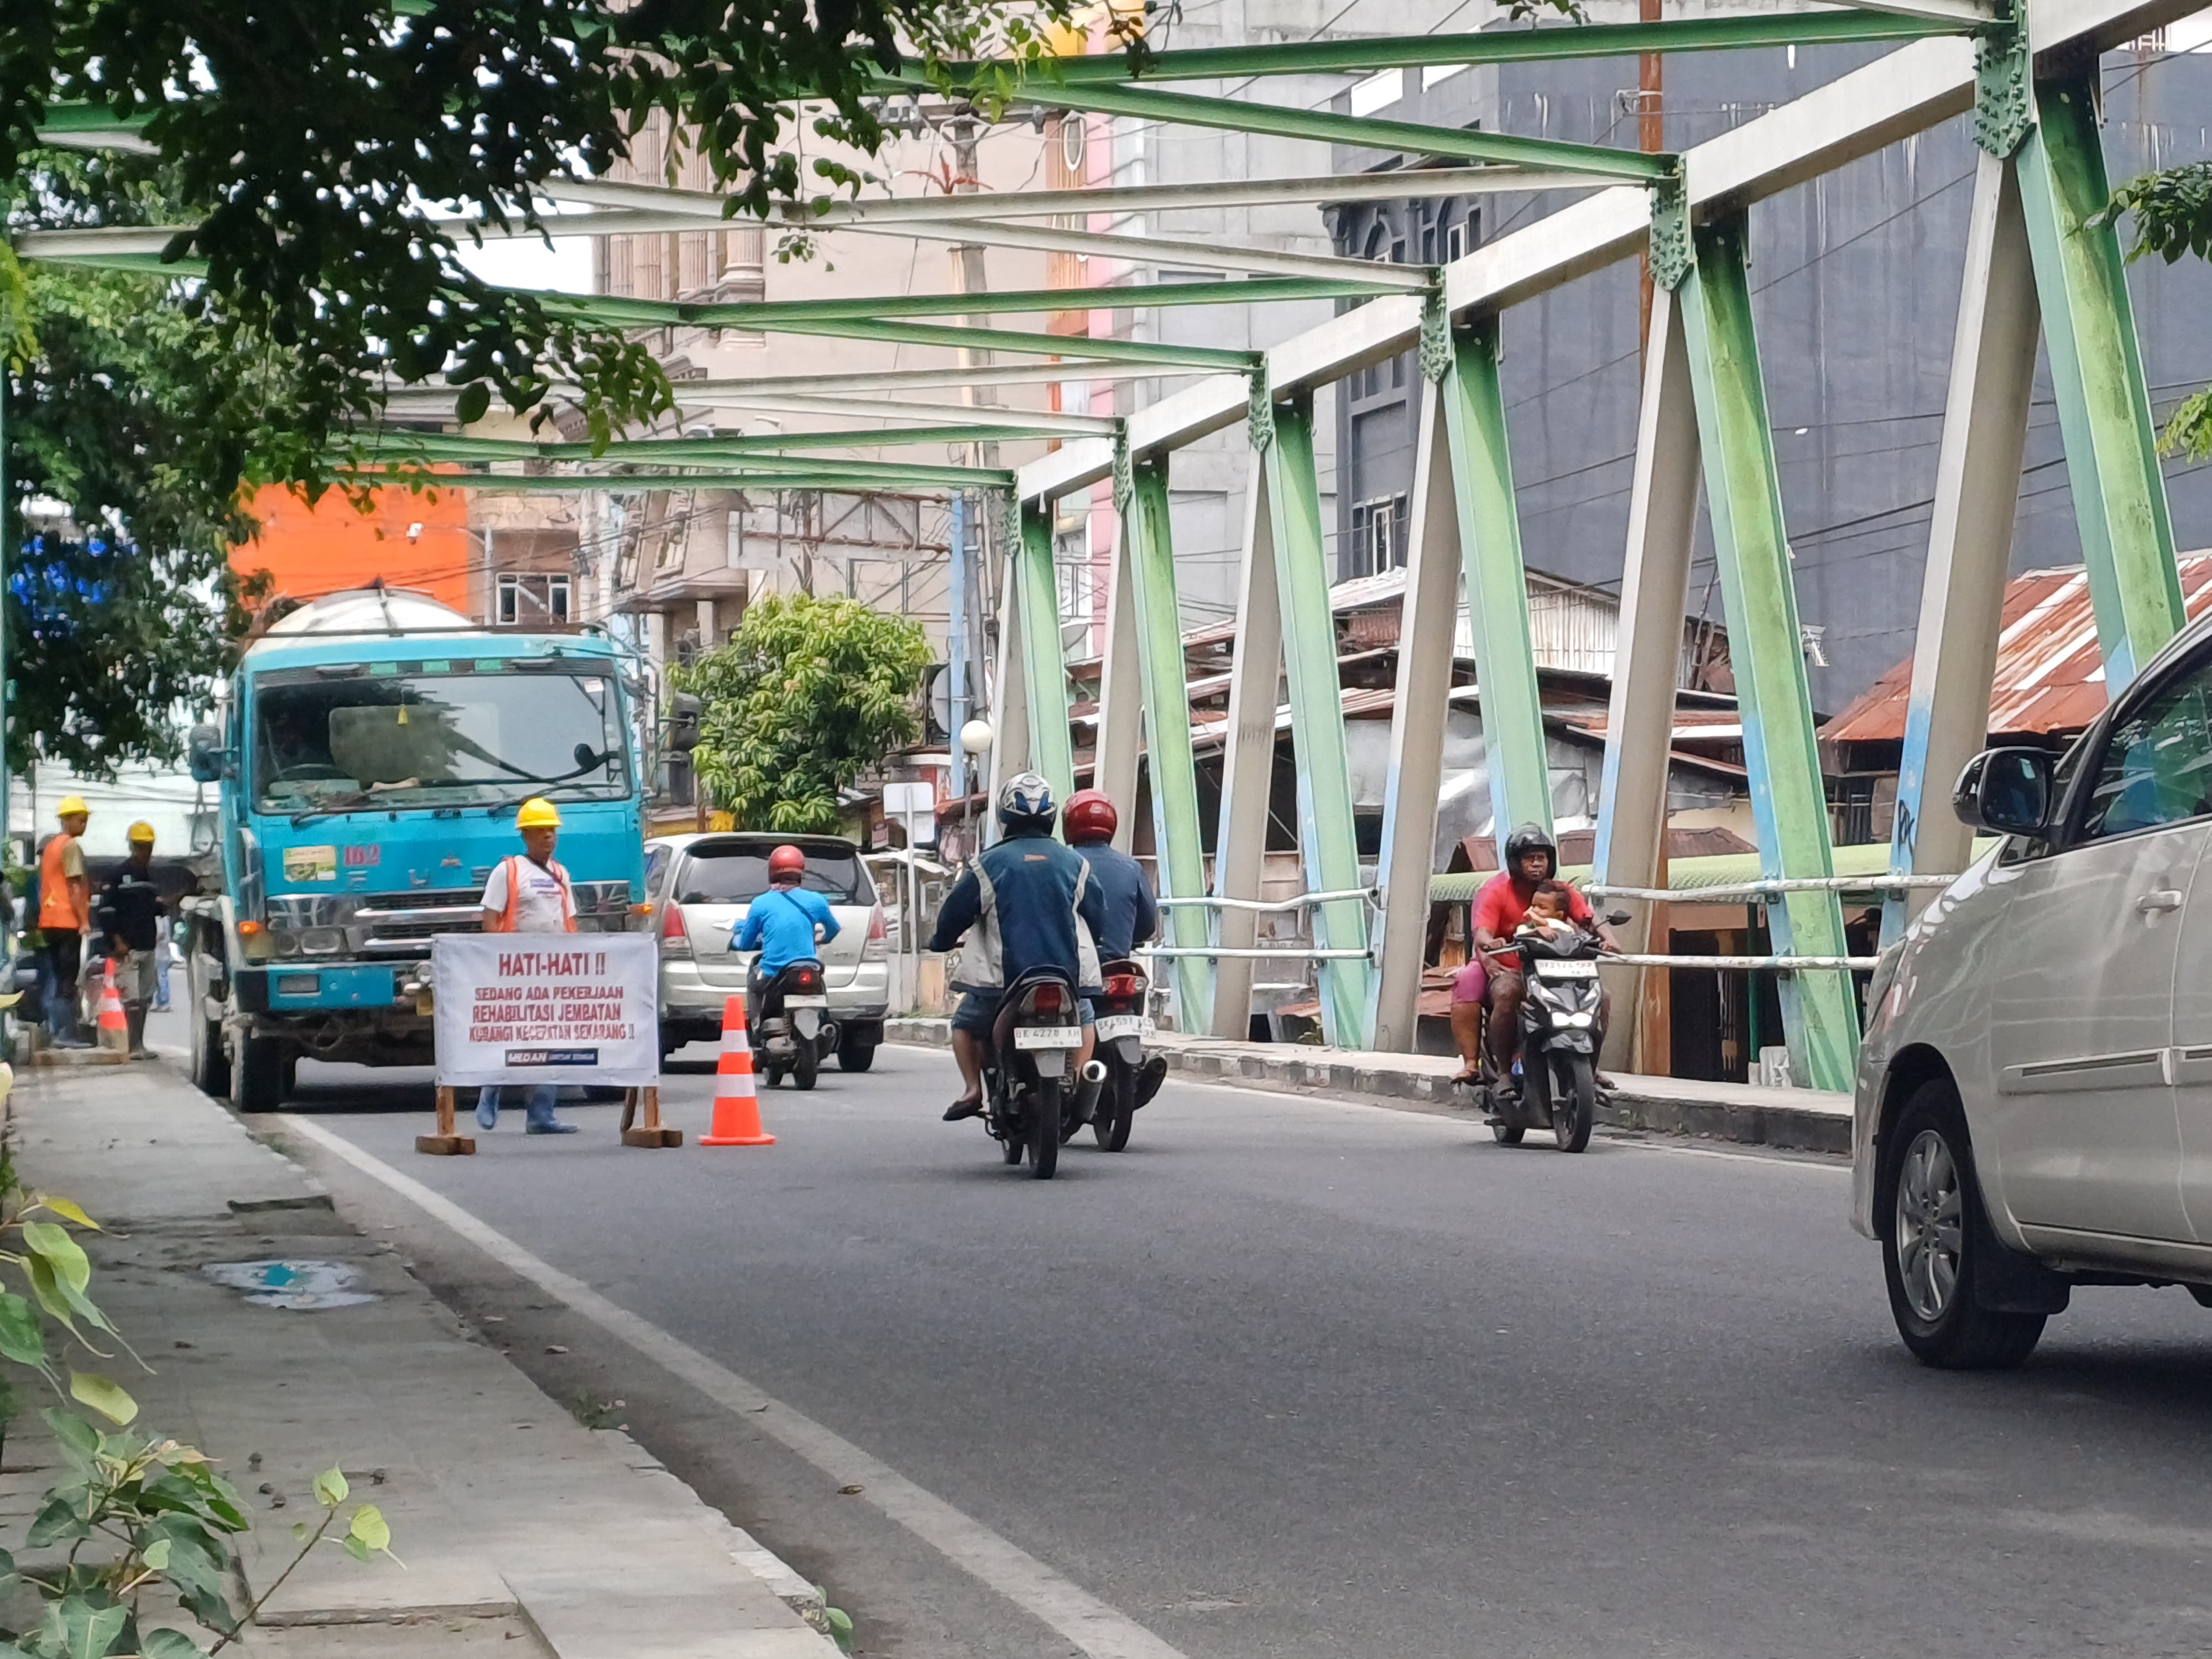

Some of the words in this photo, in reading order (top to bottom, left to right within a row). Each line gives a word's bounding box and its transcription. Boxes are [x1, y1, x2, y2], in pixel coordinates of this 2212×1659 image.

[499, 952, 589, 977] HATI-HATI
[595, 952, 606, 975] !!
[475, 987, 522, 1001] SEDANG
[526, 987, 550, 1000] ADA
[553, 986, 624, 1000] PEKERJAAN
[473, 1004, 554, 1022] REHABILITASI
[558, 1003, 621, 1021] JEMBATAN
[574, 1024, 626, 1040] SEKARANG
